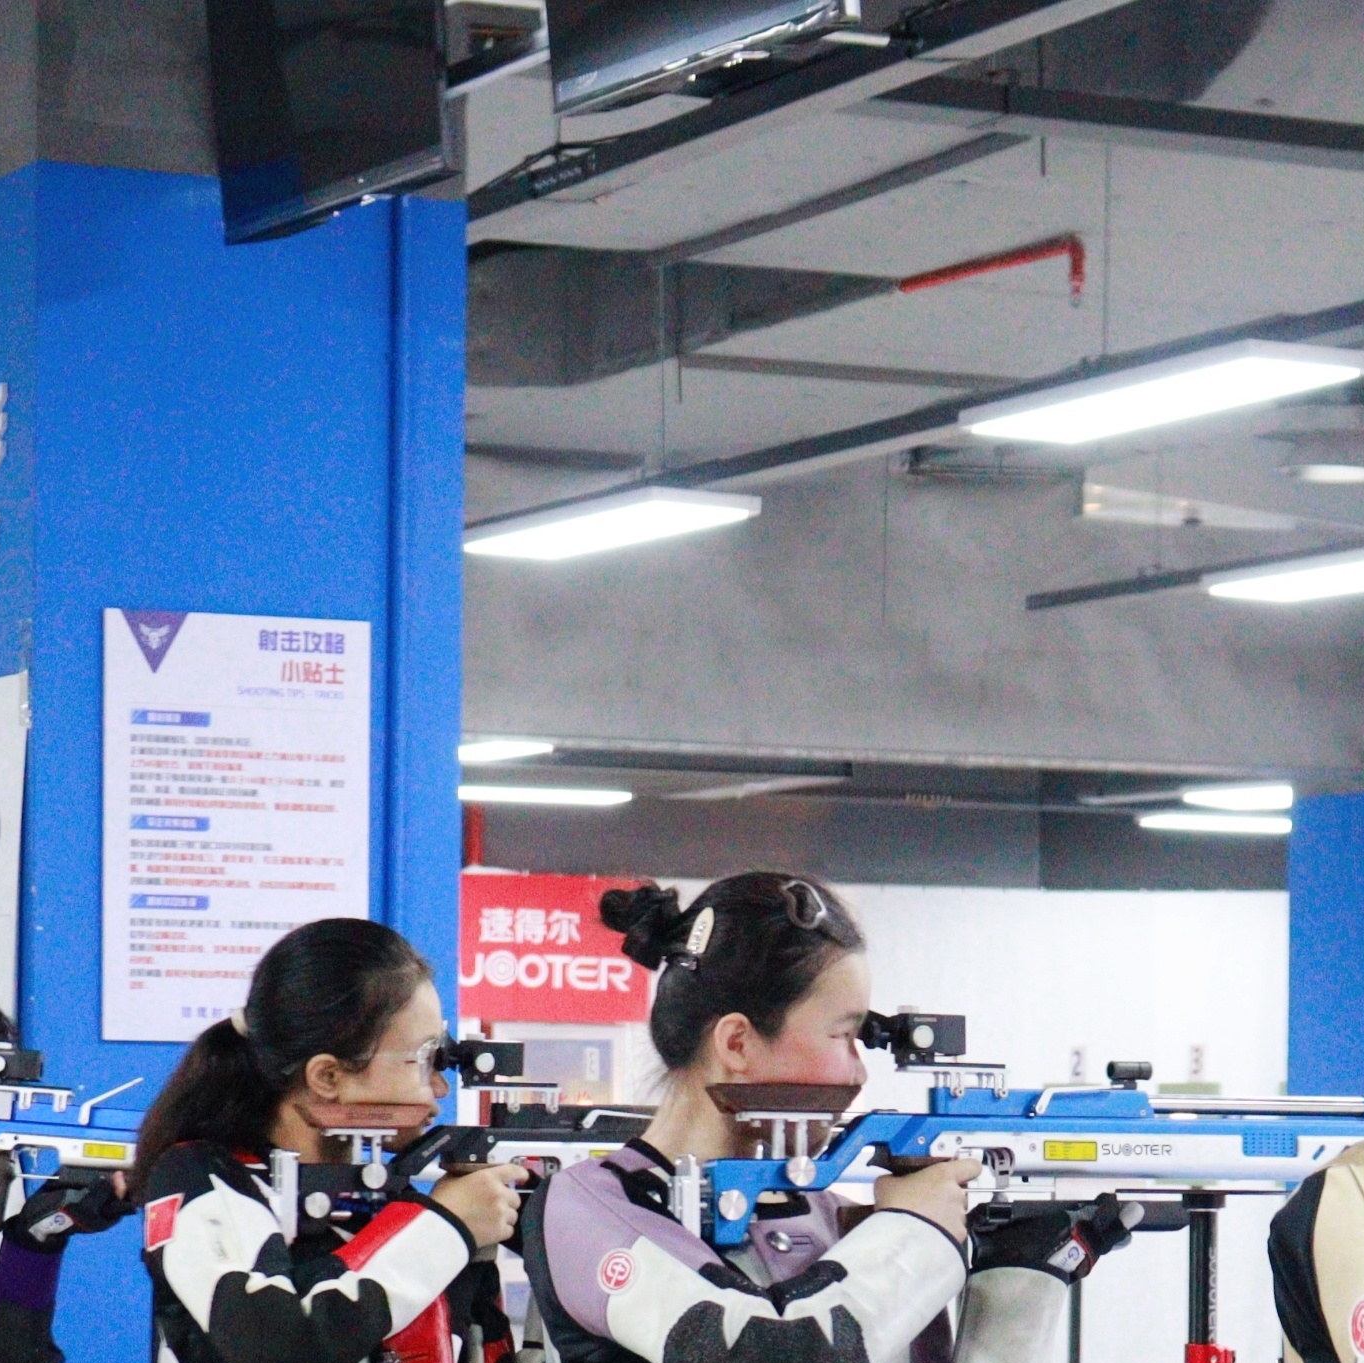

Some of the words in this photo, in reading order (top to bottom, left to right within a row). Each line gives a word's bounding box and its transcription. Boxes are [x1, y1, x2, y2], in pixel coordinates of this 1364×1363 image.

[259, 629, 346, 655] 射击攻略
[281, 660, 345, 685] 小贴士
[479, 907, 582, 946] 速得尔
[1072, 1050, 1083, 1077] 2
